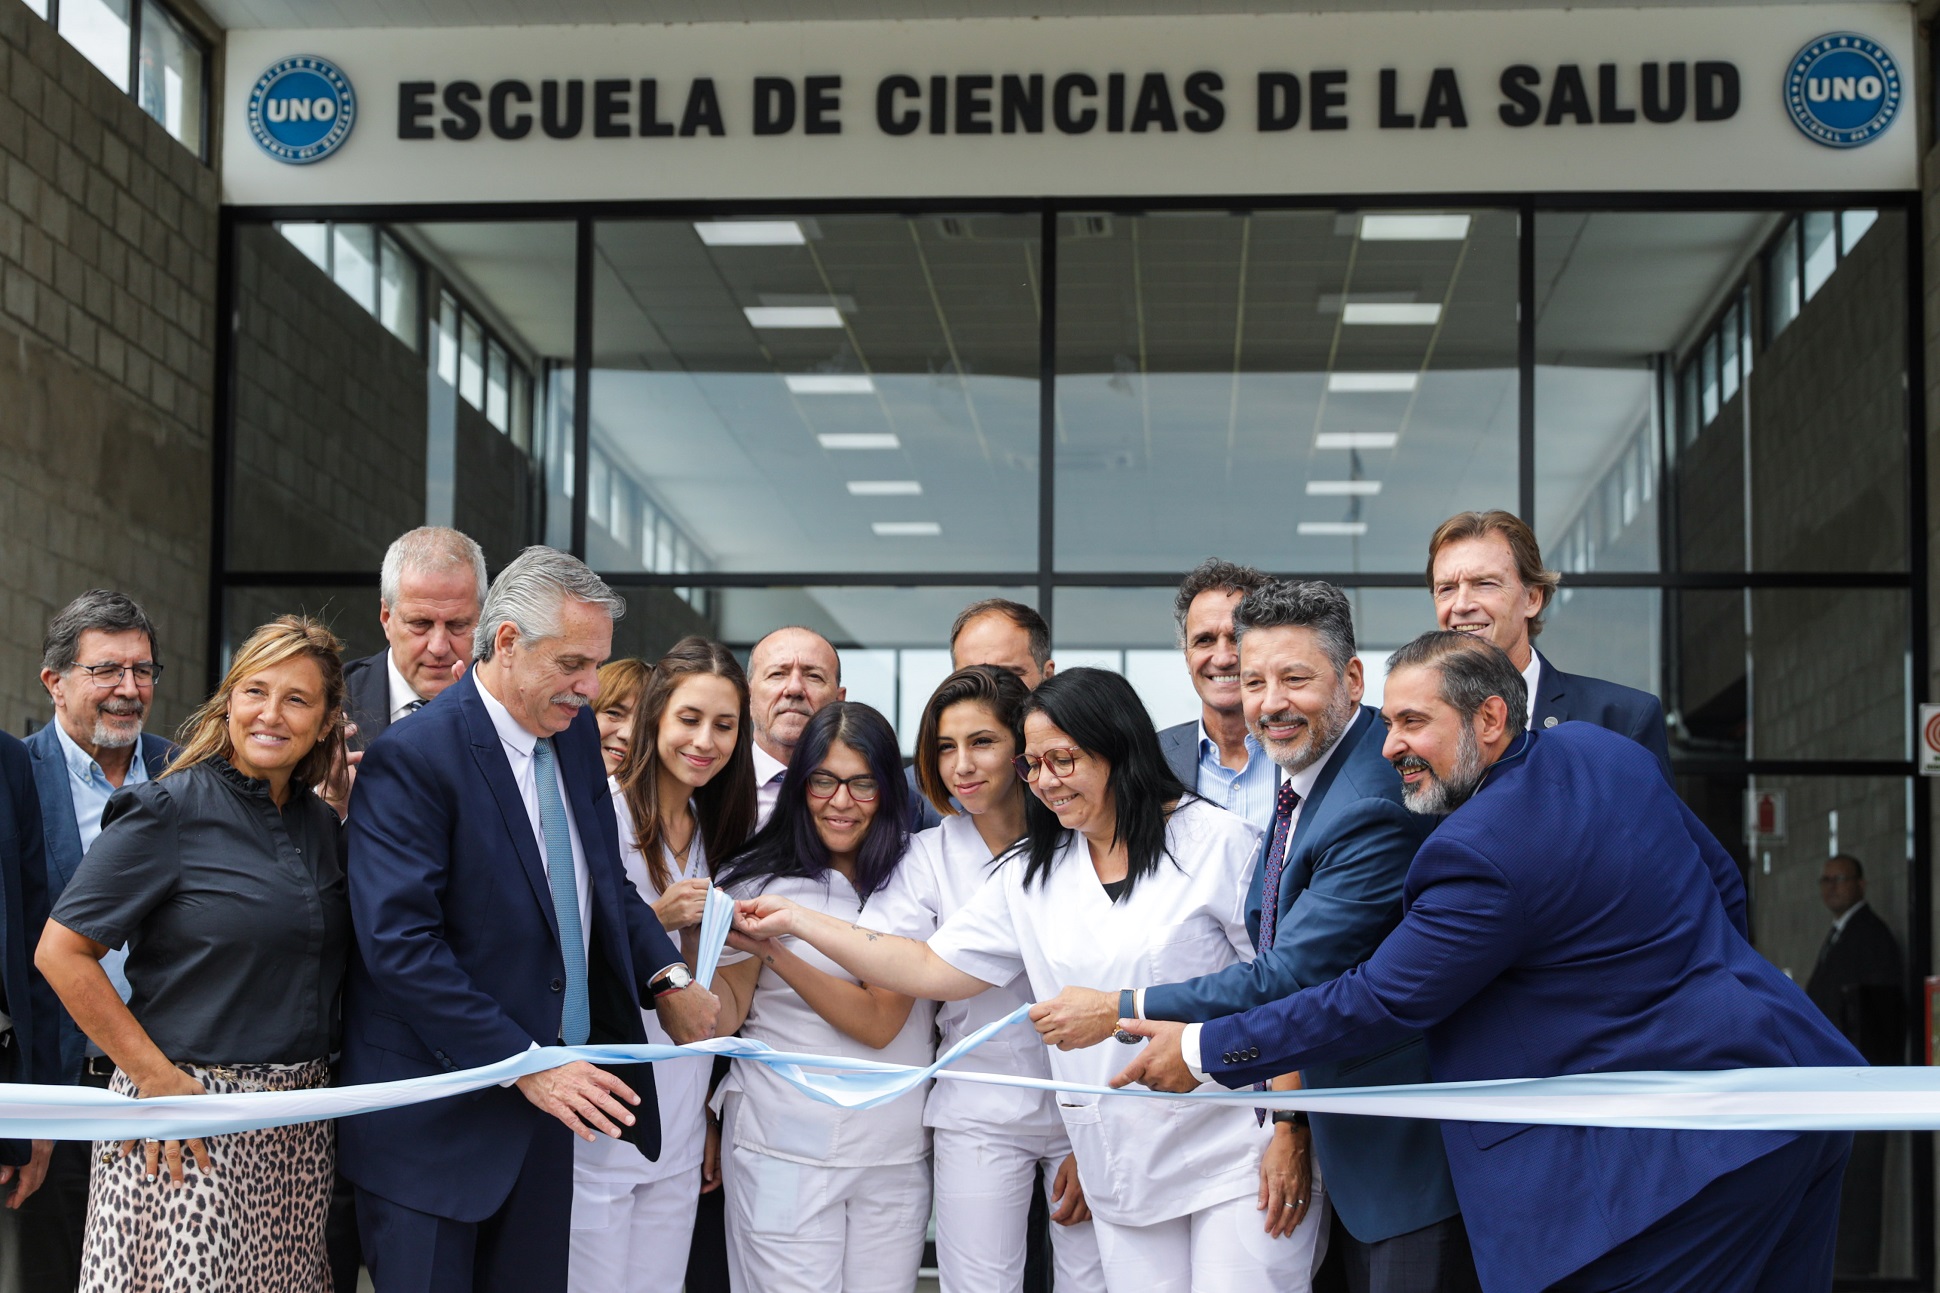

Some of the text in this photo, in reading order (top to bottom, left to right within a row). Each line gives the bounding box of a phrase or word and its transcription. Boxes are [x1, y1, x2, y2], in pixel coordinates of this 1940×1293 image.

[397, 76, 728, 142] ESCUELA
[752, 75, 843, 138] DE
[875, 69, 1227, 137] CIENCIAS
[1256, 67, 1349, 134] DE
[1377, 66, 1469, 130] LA
[1497, 60, 1742, 129] SALUD
[1808, 76, 1883, 102] UNO
[267, 97, 336, 123] UNO
